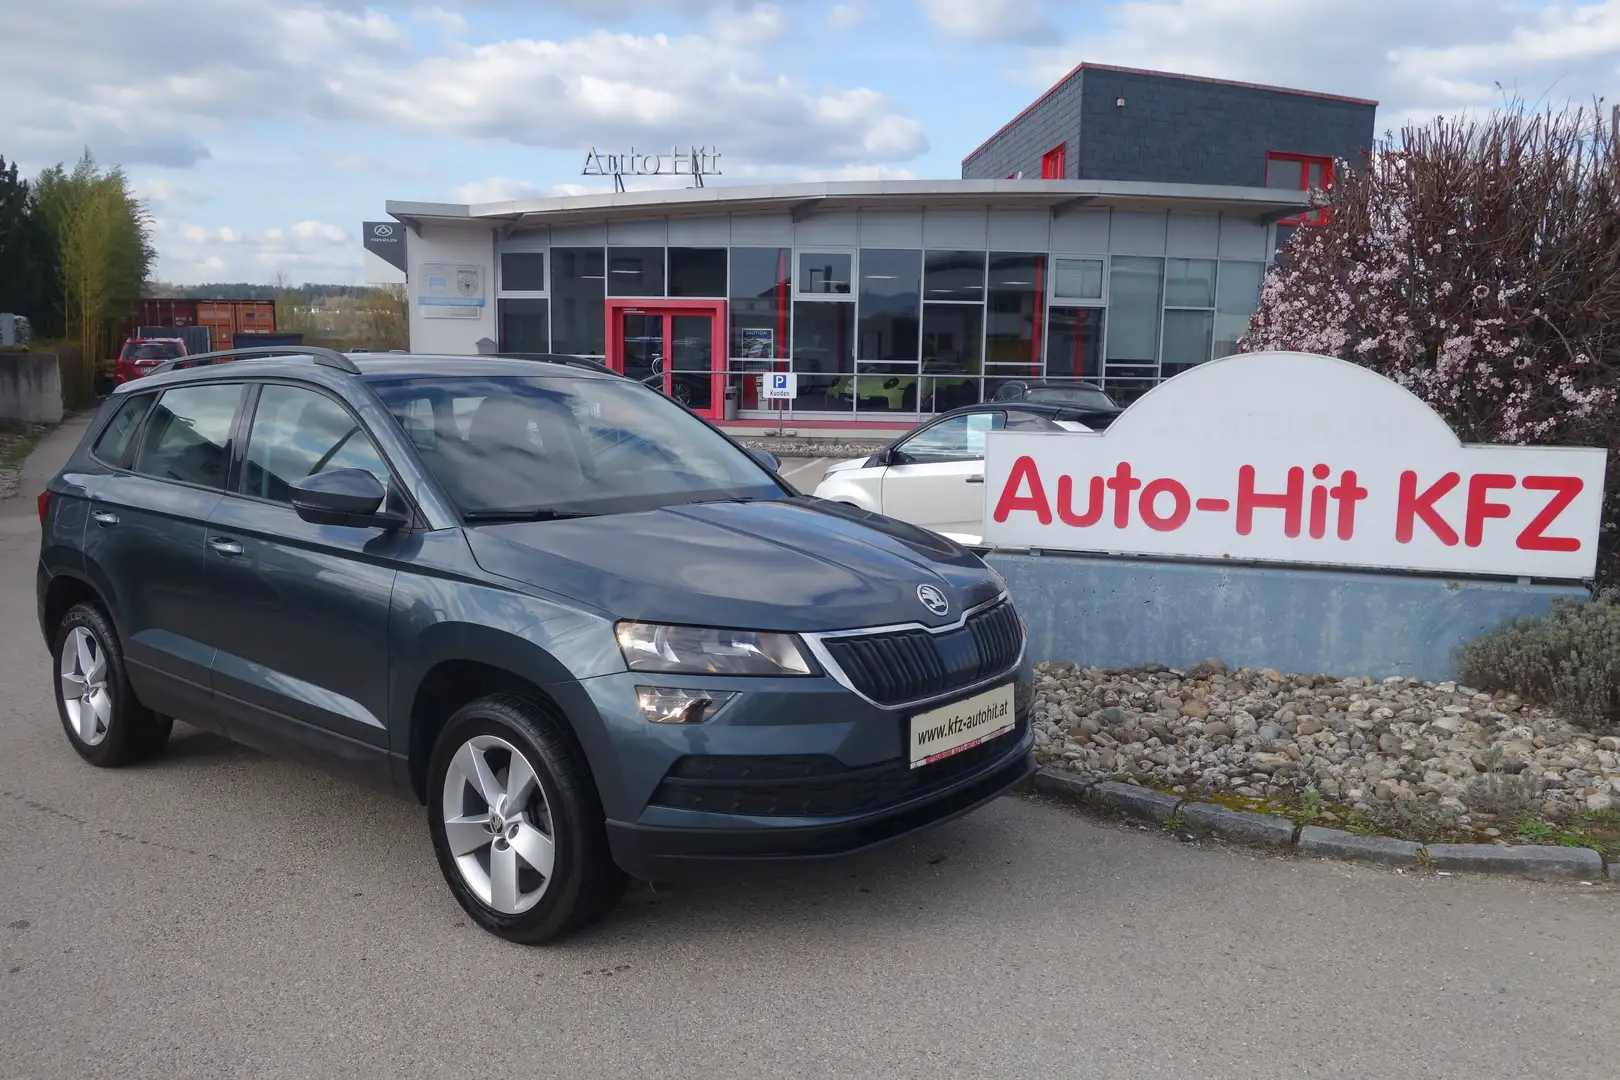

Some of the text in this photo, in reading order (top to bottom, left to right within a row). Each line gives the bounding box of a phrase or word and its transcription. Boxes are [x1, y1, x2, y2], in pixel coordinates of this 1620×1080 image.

[580, 145, 722, 175] Auto Hit
[775, 375, 784, 388] P
[993, 455, 1585, 552] Auto-Hit KFZ
[918, 700, 1008, 746] www.kfz-autohit.at
